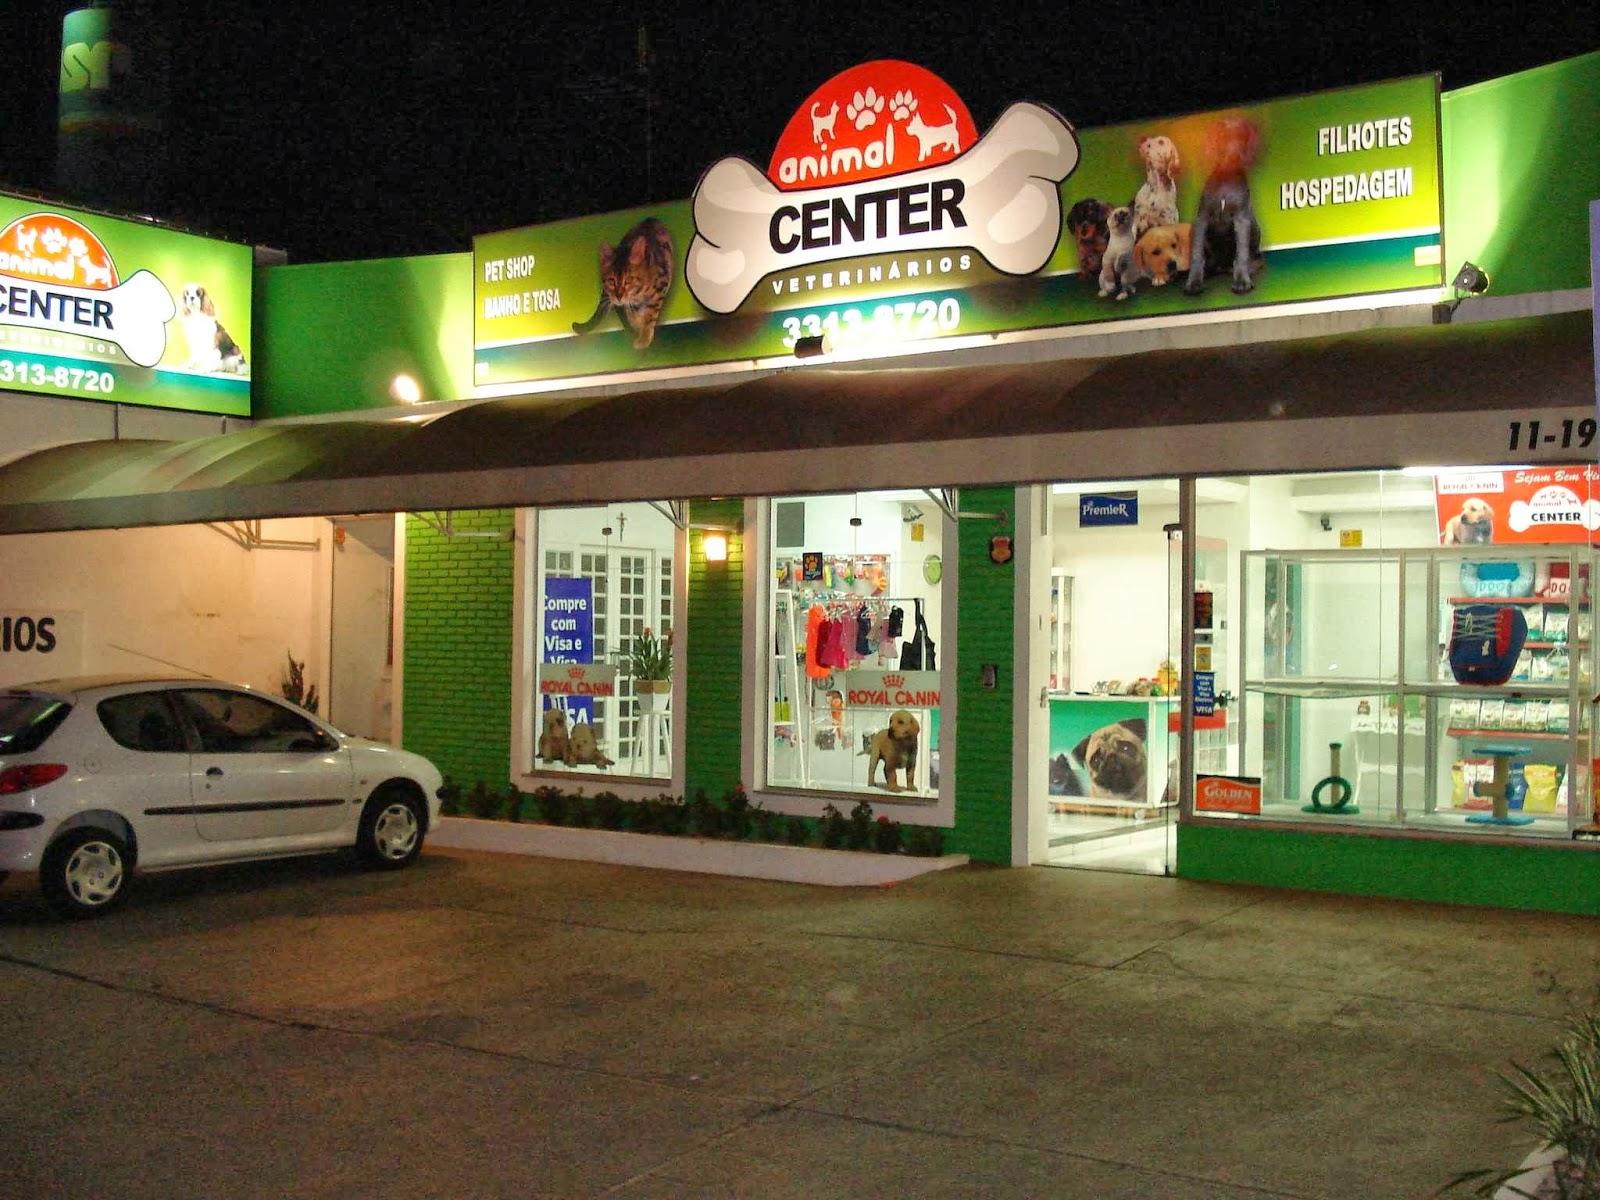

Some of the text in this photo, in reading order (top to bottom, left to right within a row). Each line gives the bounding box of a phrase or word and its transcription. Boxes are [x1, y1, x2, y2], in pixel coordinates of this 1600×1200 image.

[1318, 116, 1413, 156] FILHOTES
[779, 122, 896, 184] animal
[1280, 167, 1413, 210] HOSPEDAGEM
[769, 178, 968, 255] CENTER
[484, 254, 535, 283] PET SHOP
[772, 255, 971, 295] VETERINÁRIOS
[522, 291, 531, 314] E
[532, 288, 561, 312] TOSA
[1509, 418, 1597, 450] 11-19
[1515, 471, 1551, 485] Sejam
[1554, 470, 1580, 483] Bem
[1531, 512, 1581, 522] CENTER
[1551, 582, 1571, 593] DO
[0, 616, 56, 653] IOS
[551, 618, 577, 631] com
[545, 635, 582, 651] Visa e
[541, 680, 614, 696] ROYAL CANIN
[848, 689, 940, 706] ROYAL CANIN
